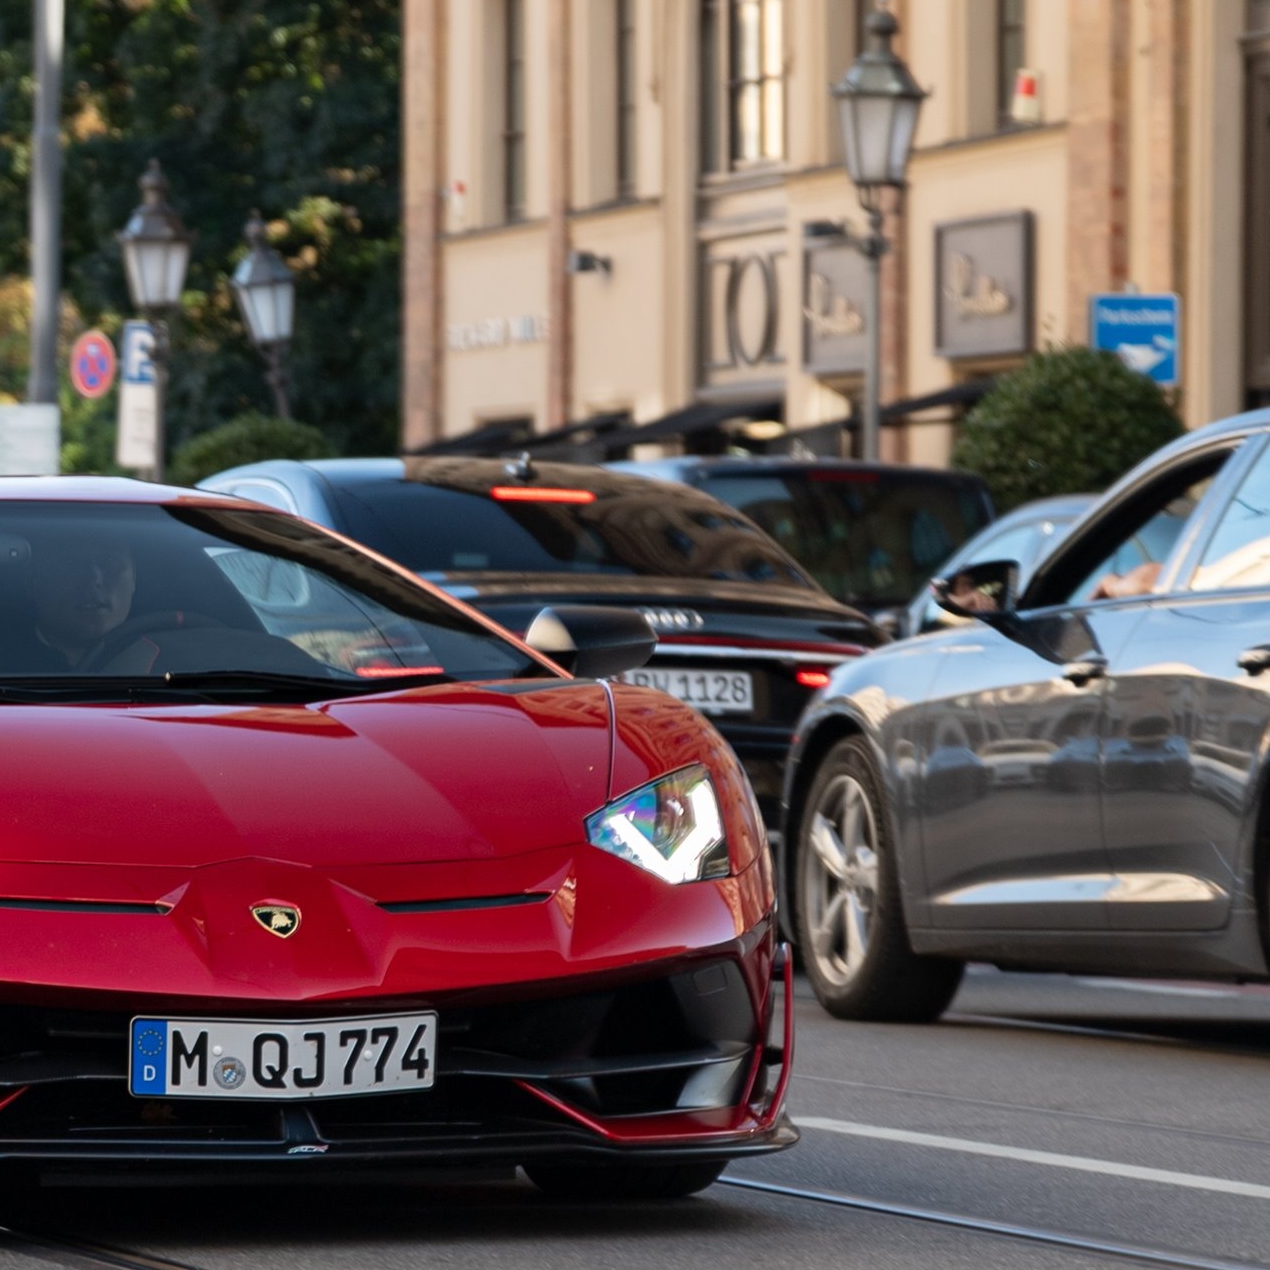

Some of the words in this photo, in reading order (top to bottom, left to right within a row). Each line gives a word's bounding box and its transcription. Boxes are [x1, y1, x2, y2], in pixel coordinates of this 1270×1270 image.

[677, 675, 748, 703] 1128
[143, 1064, 157, 1082] D
[171, 1030, 209, 1087] M
[252, 1032, 326, 1089] QJ
[339, 1024, 430, 1085] 774
